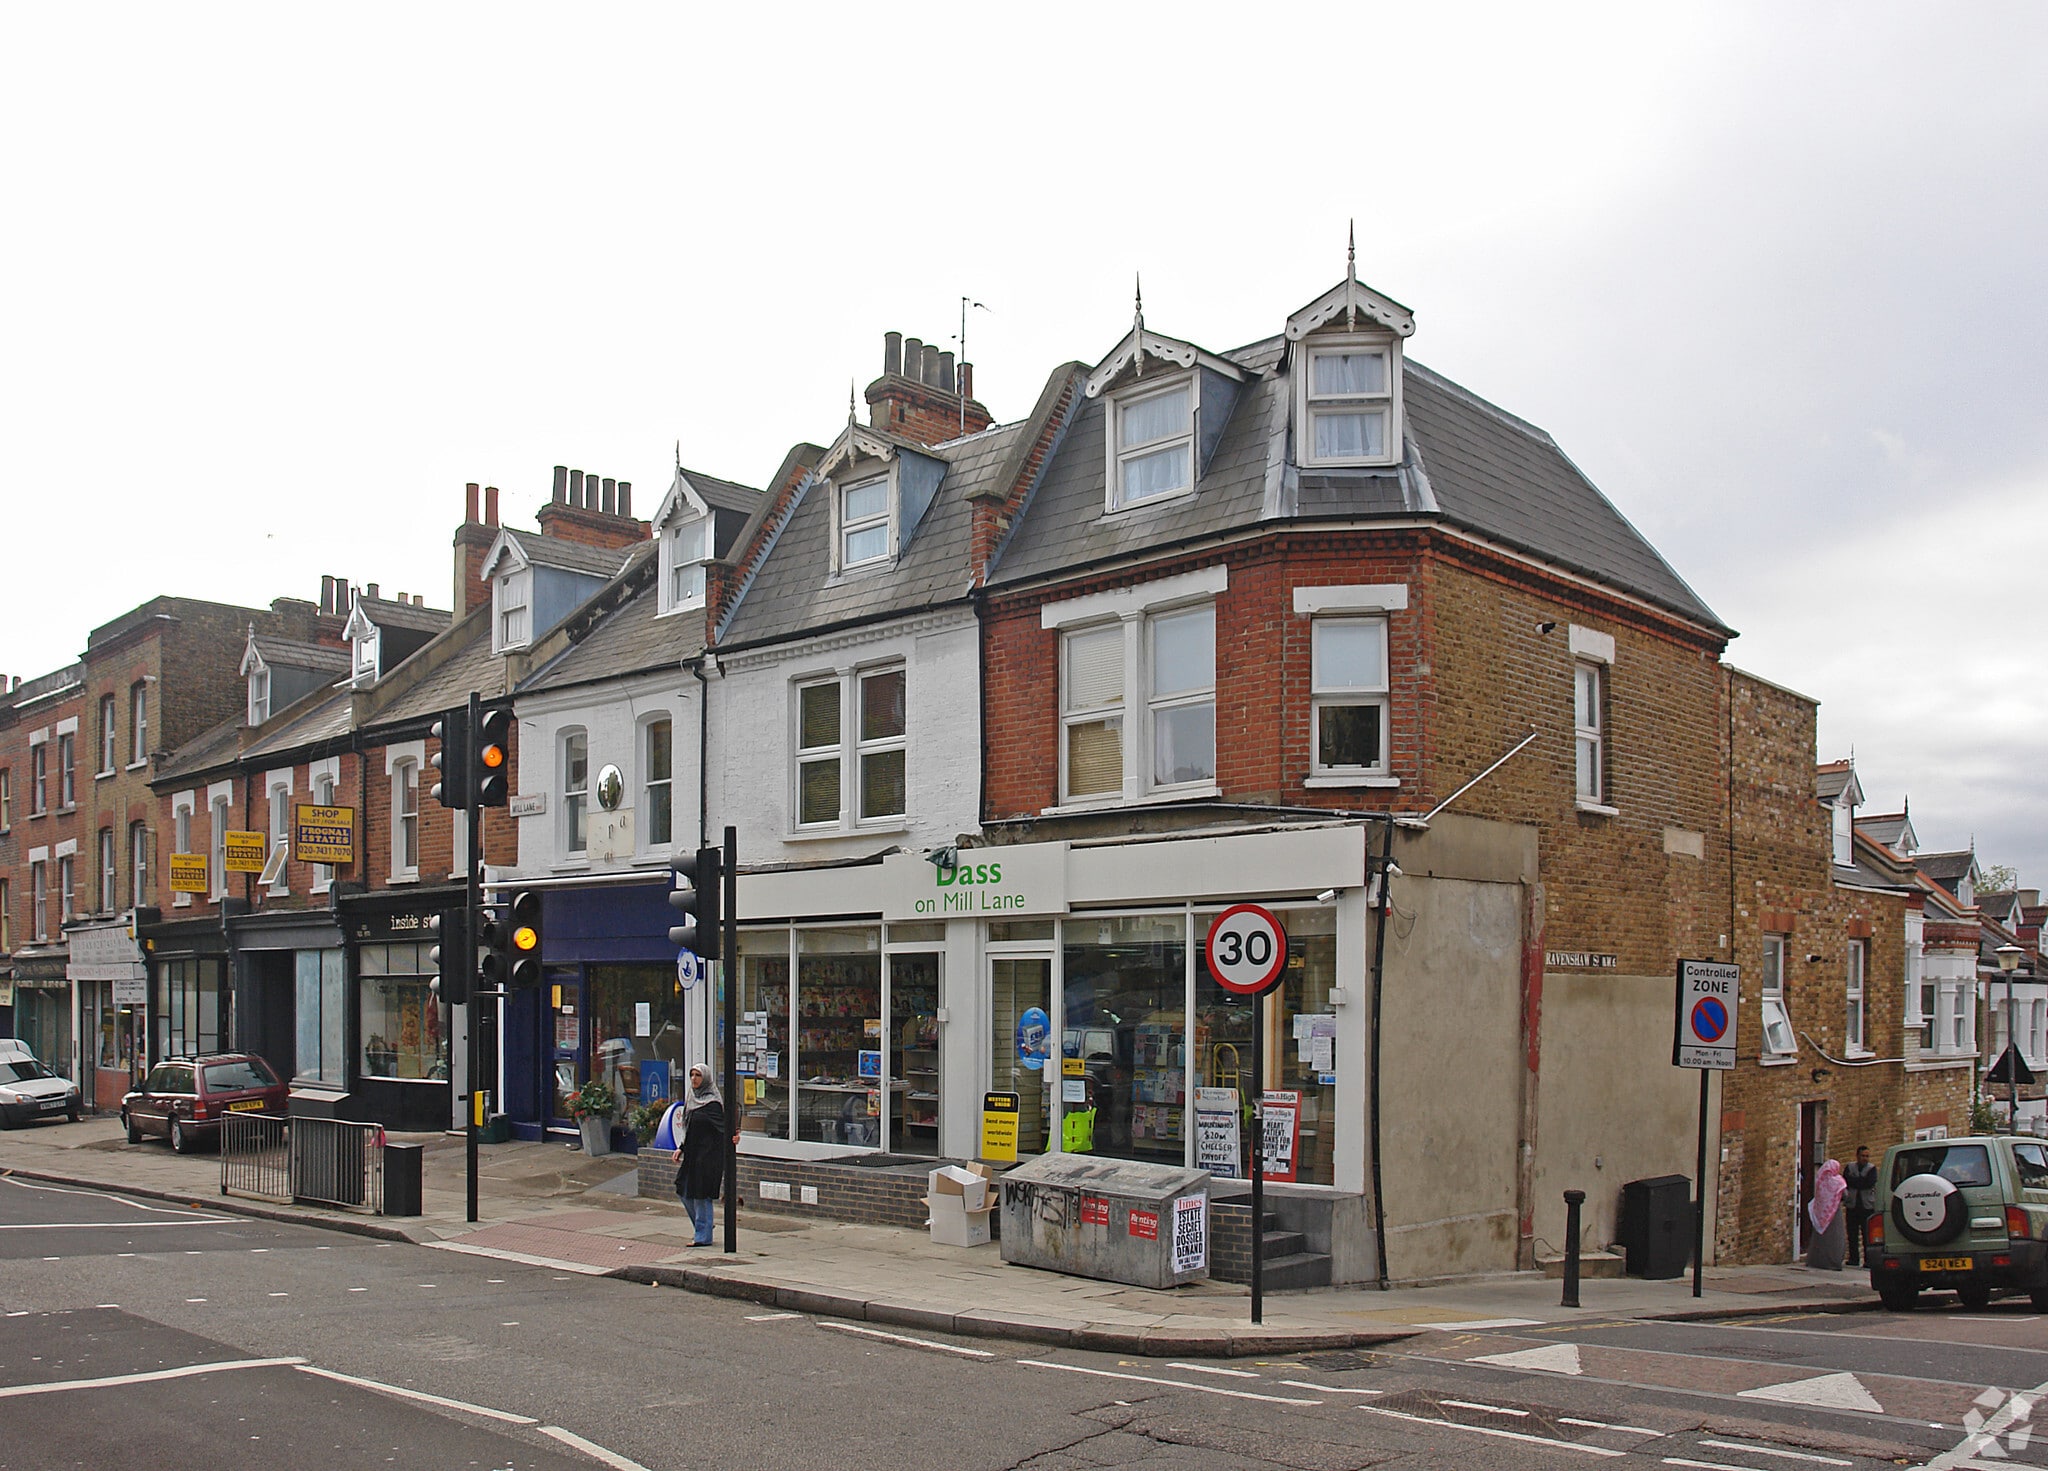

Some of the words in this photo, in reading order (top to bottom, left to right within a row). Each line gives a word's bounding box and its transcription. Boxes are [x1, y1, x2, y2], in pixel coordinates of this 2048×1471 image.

[311, 809, 339, 818] SHOP
[512, 804, 523, 812] MILL
[523, 802, 535, 811] LANE
[301, 827, 349, 836] FROGNAL
[301, 834, 349, 844] ESTATES
[333, 847, 352, 856] 7070
[936, 863, 1002, 887] Dass
[915, 899, 936, 913] on
[944, 891, 973, 912] Mill
[981, 890, 1025, 910] Lane
[390, 914, 419, 930] inside
[1218, 930, 1272, 966] 30
[1546, 952, 1590, 967] RAVENSHAW
[1686, 965, 1738, 979] Controlled
[1693, 980, 1729, 993] ZONE
[1683, 1057, 1702, 1065] 10.00
[651, 1083, 659, 1098] B
[1263, 1093, 1295, 1101] am&High
[1263, 1109, 1292, 1117] am&High
[1904, 1190, 1941, 1199] Korando
[1177, 1199, 1203, 1210] Times
[1178, 1209, 1201, 1224] ESTATE
[1178, 1221, 1201, 1235] SECRET
[1176, 1232, 1203, 1247] DOSSIER
[1176, 1243, 1203, 1258] DEMAND
[1925, 1259, 1945, 1269] S241
